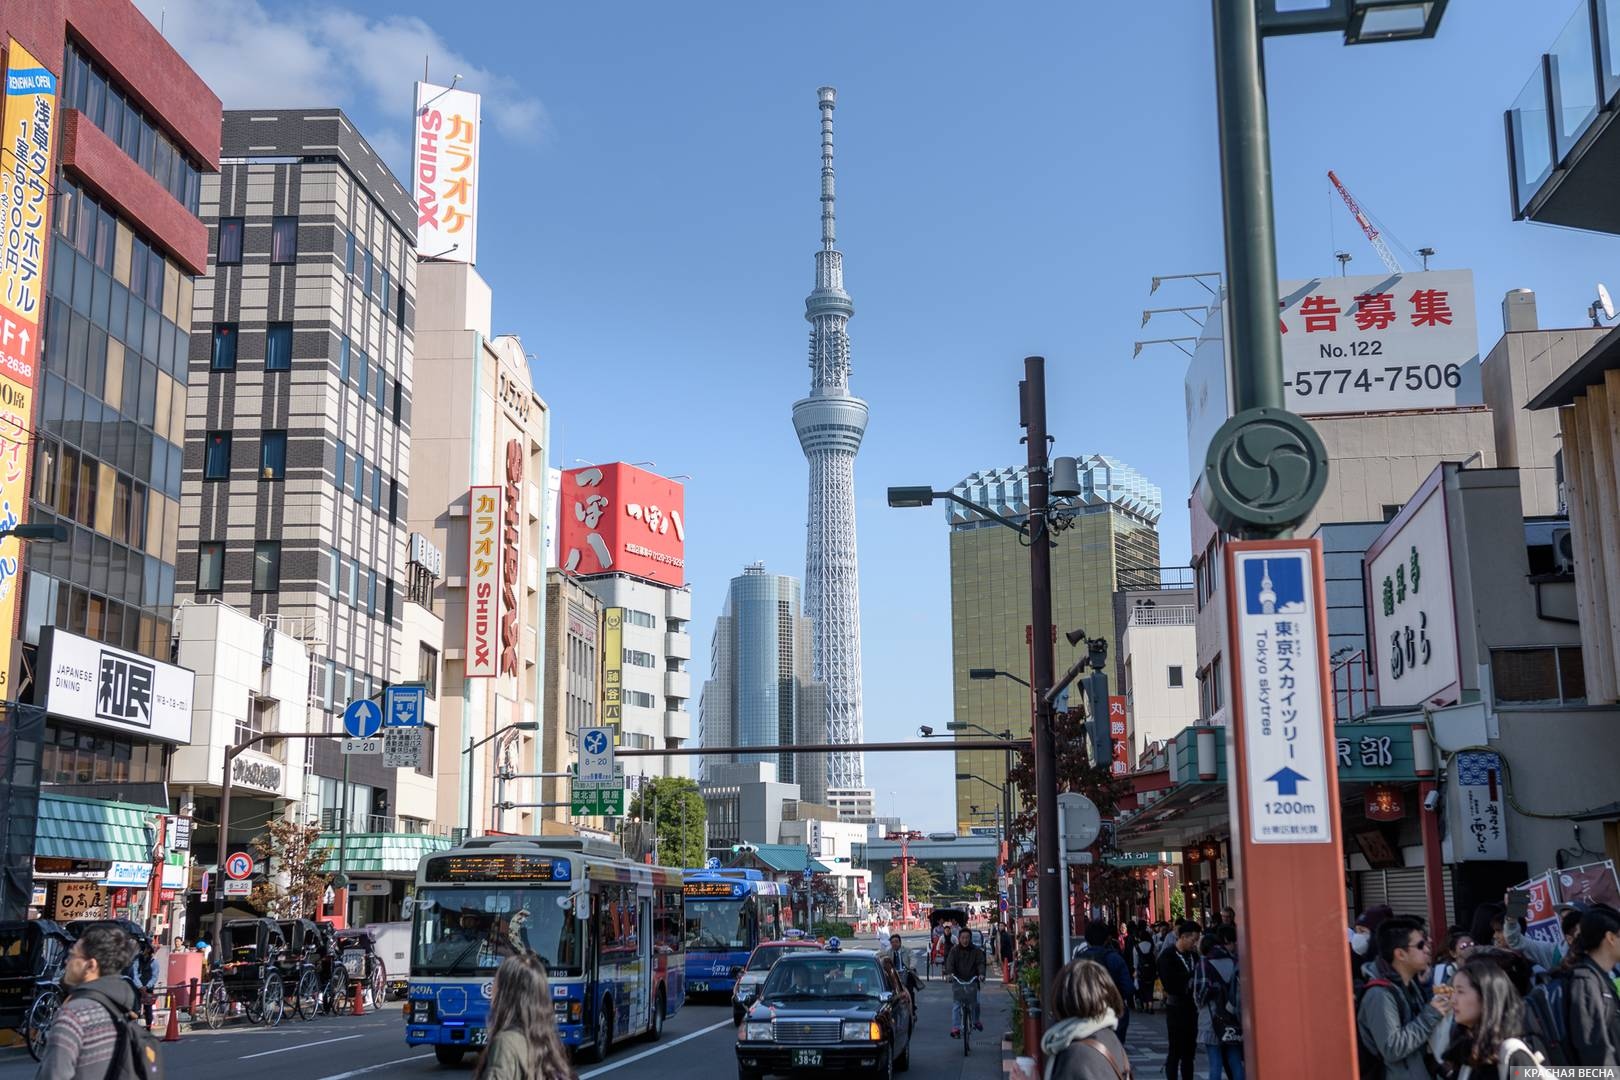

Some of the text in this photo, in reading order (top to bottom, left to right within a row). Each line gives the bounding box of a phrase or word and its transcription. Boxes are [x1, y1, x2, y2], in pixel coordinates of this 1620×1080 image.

[9, 76, 51, 89] RENEWAL OPEN
[418, 109, 442, 231] SHIDAX
[442, 114, 474, 234] カラオケ
[17, 95, 51, 312] 浅草タウンホテル
[1280, 289, 1452, 334] 告募集
[1320, 340, 1382, 358] No.122
[0, 383, 24, 409] 0席
[564, 468, 613, 571] つぼ八
[626, 503, 685, 542] つぼ八
[474, 494, 495, 667] カラオケ SHIDAX
[501, 438, 523, 678] SHIDAX
[55, 677, 81, 692] DINING
[56, 664, 93, 682] JAPANESE
[100, 658, 153, 723] 和民
[1256, 630, 1272, 736] Tokyo skytree
[1274, 621, 1298, 759] 東京スカイツリー
[1264, 801, 1316, 816] 1200m
[114, 863, 152, 881] FamilyMar
[798, 1055, 822, 1065] 38-67
